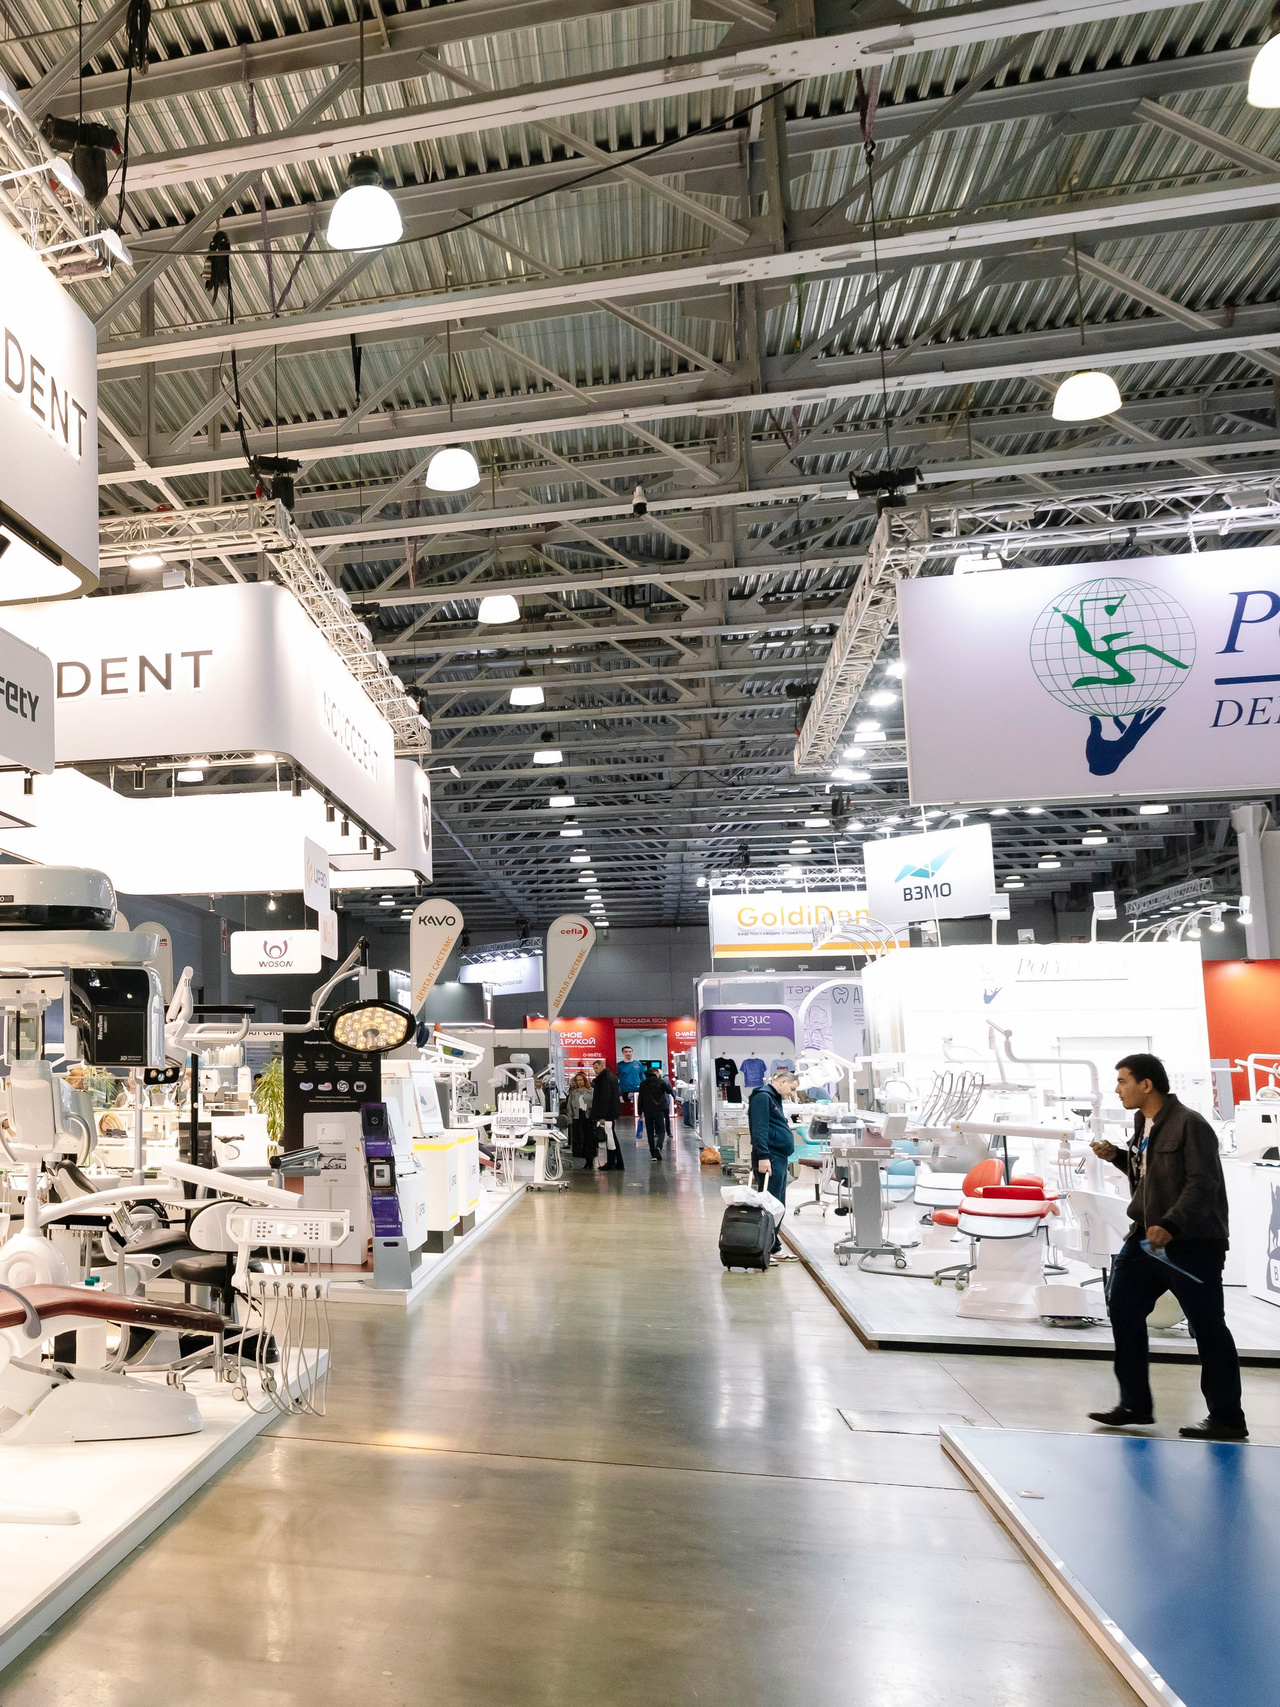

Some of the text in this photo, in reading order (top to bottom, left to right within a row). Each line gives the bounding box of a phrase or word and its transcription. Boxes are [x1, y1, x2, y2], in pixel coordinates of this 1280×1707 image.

[1215, 589, 1280, 654] P
[1210, 697, 1280, 728] DE
[418, 915, 456, 927] KAVO
[258, 960, 294, 968] WOSON
[416, 935, 454, 1003] ДЕНТАЛ СИСТЕМС
[552, 948, 587, 1009] ДЕНТАЛ СИСТЕМС
[564, 1036, 596, 1045] РУКОЙ
